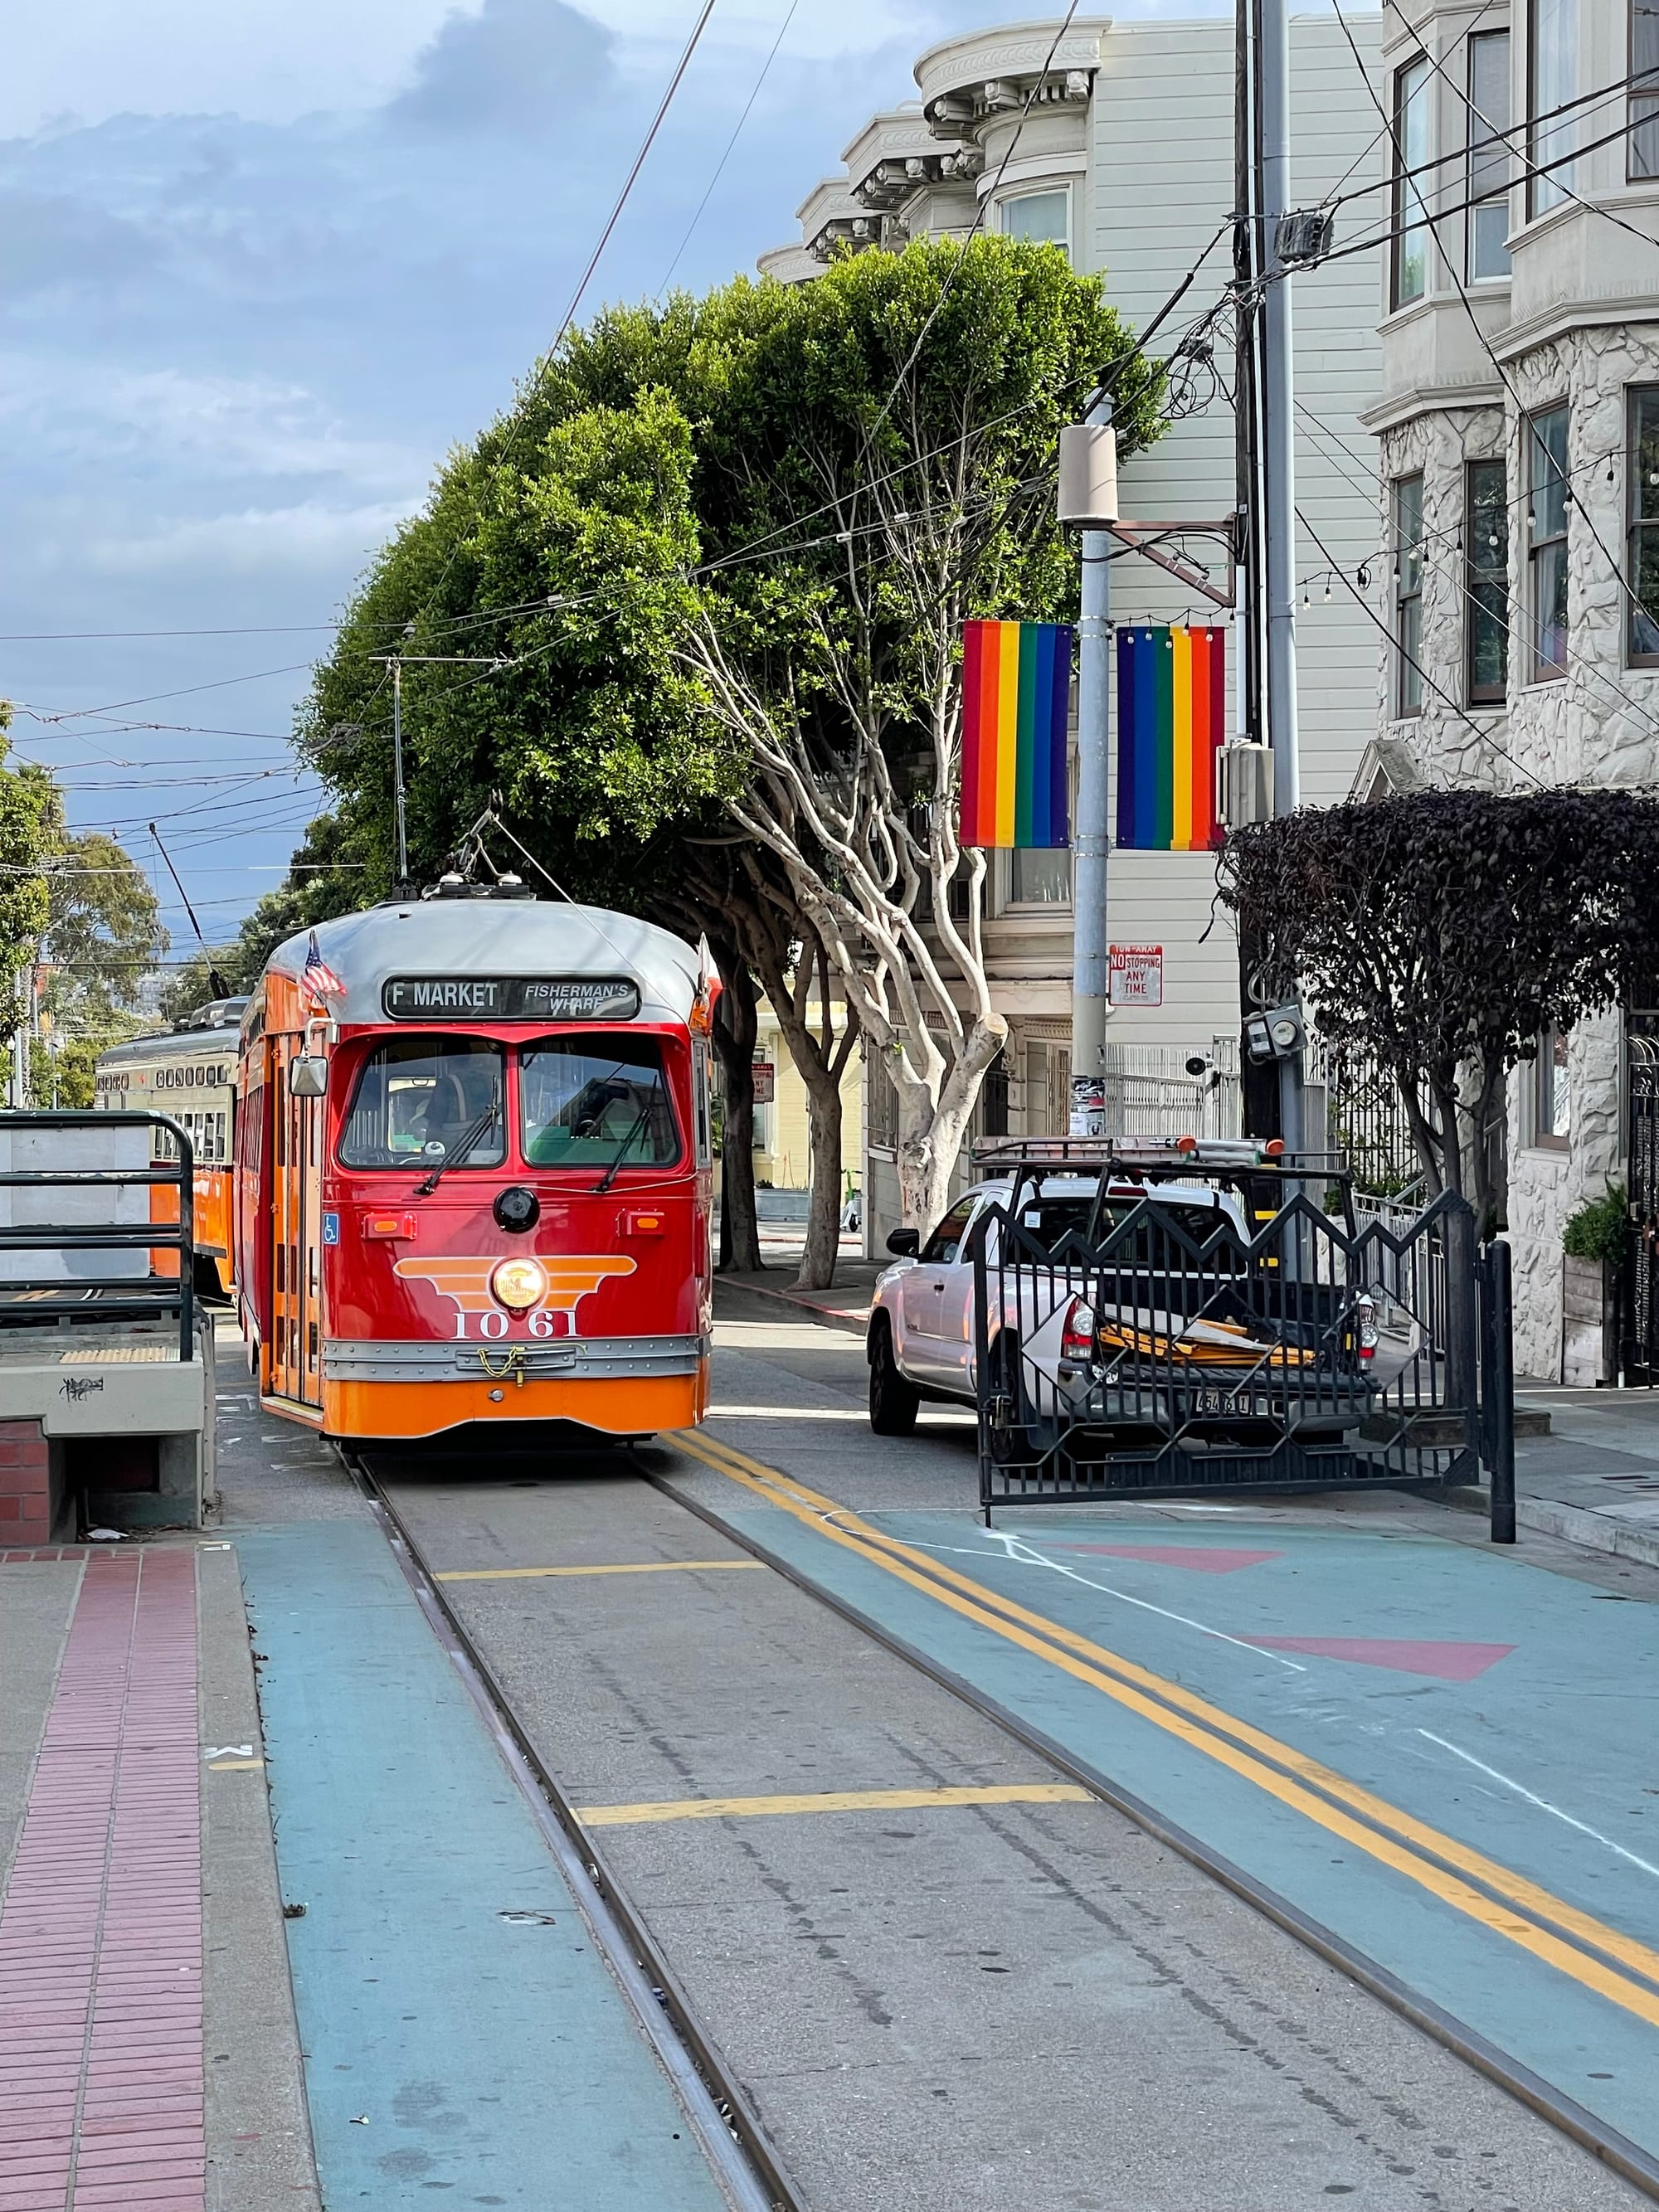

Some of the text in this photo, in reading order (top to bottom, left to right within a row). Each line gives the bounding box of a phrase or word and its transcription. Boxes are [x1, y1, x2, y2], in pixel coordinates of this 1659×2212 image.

[1116, 945, 1157, 953] TOW-AWAY
[1111, 954, 1160, 969] NO STOPPING
[1126, 970, 1146, 981] ANY
[392, 981, 498, 1007] F MARKET
[524, 984, 629, 998] FISHERMAN'S
[1125, 983, 1147, 994] TIME
[549, 997, 604, 1010] WHARF
[450, 1311, 582, 1339] 1061
